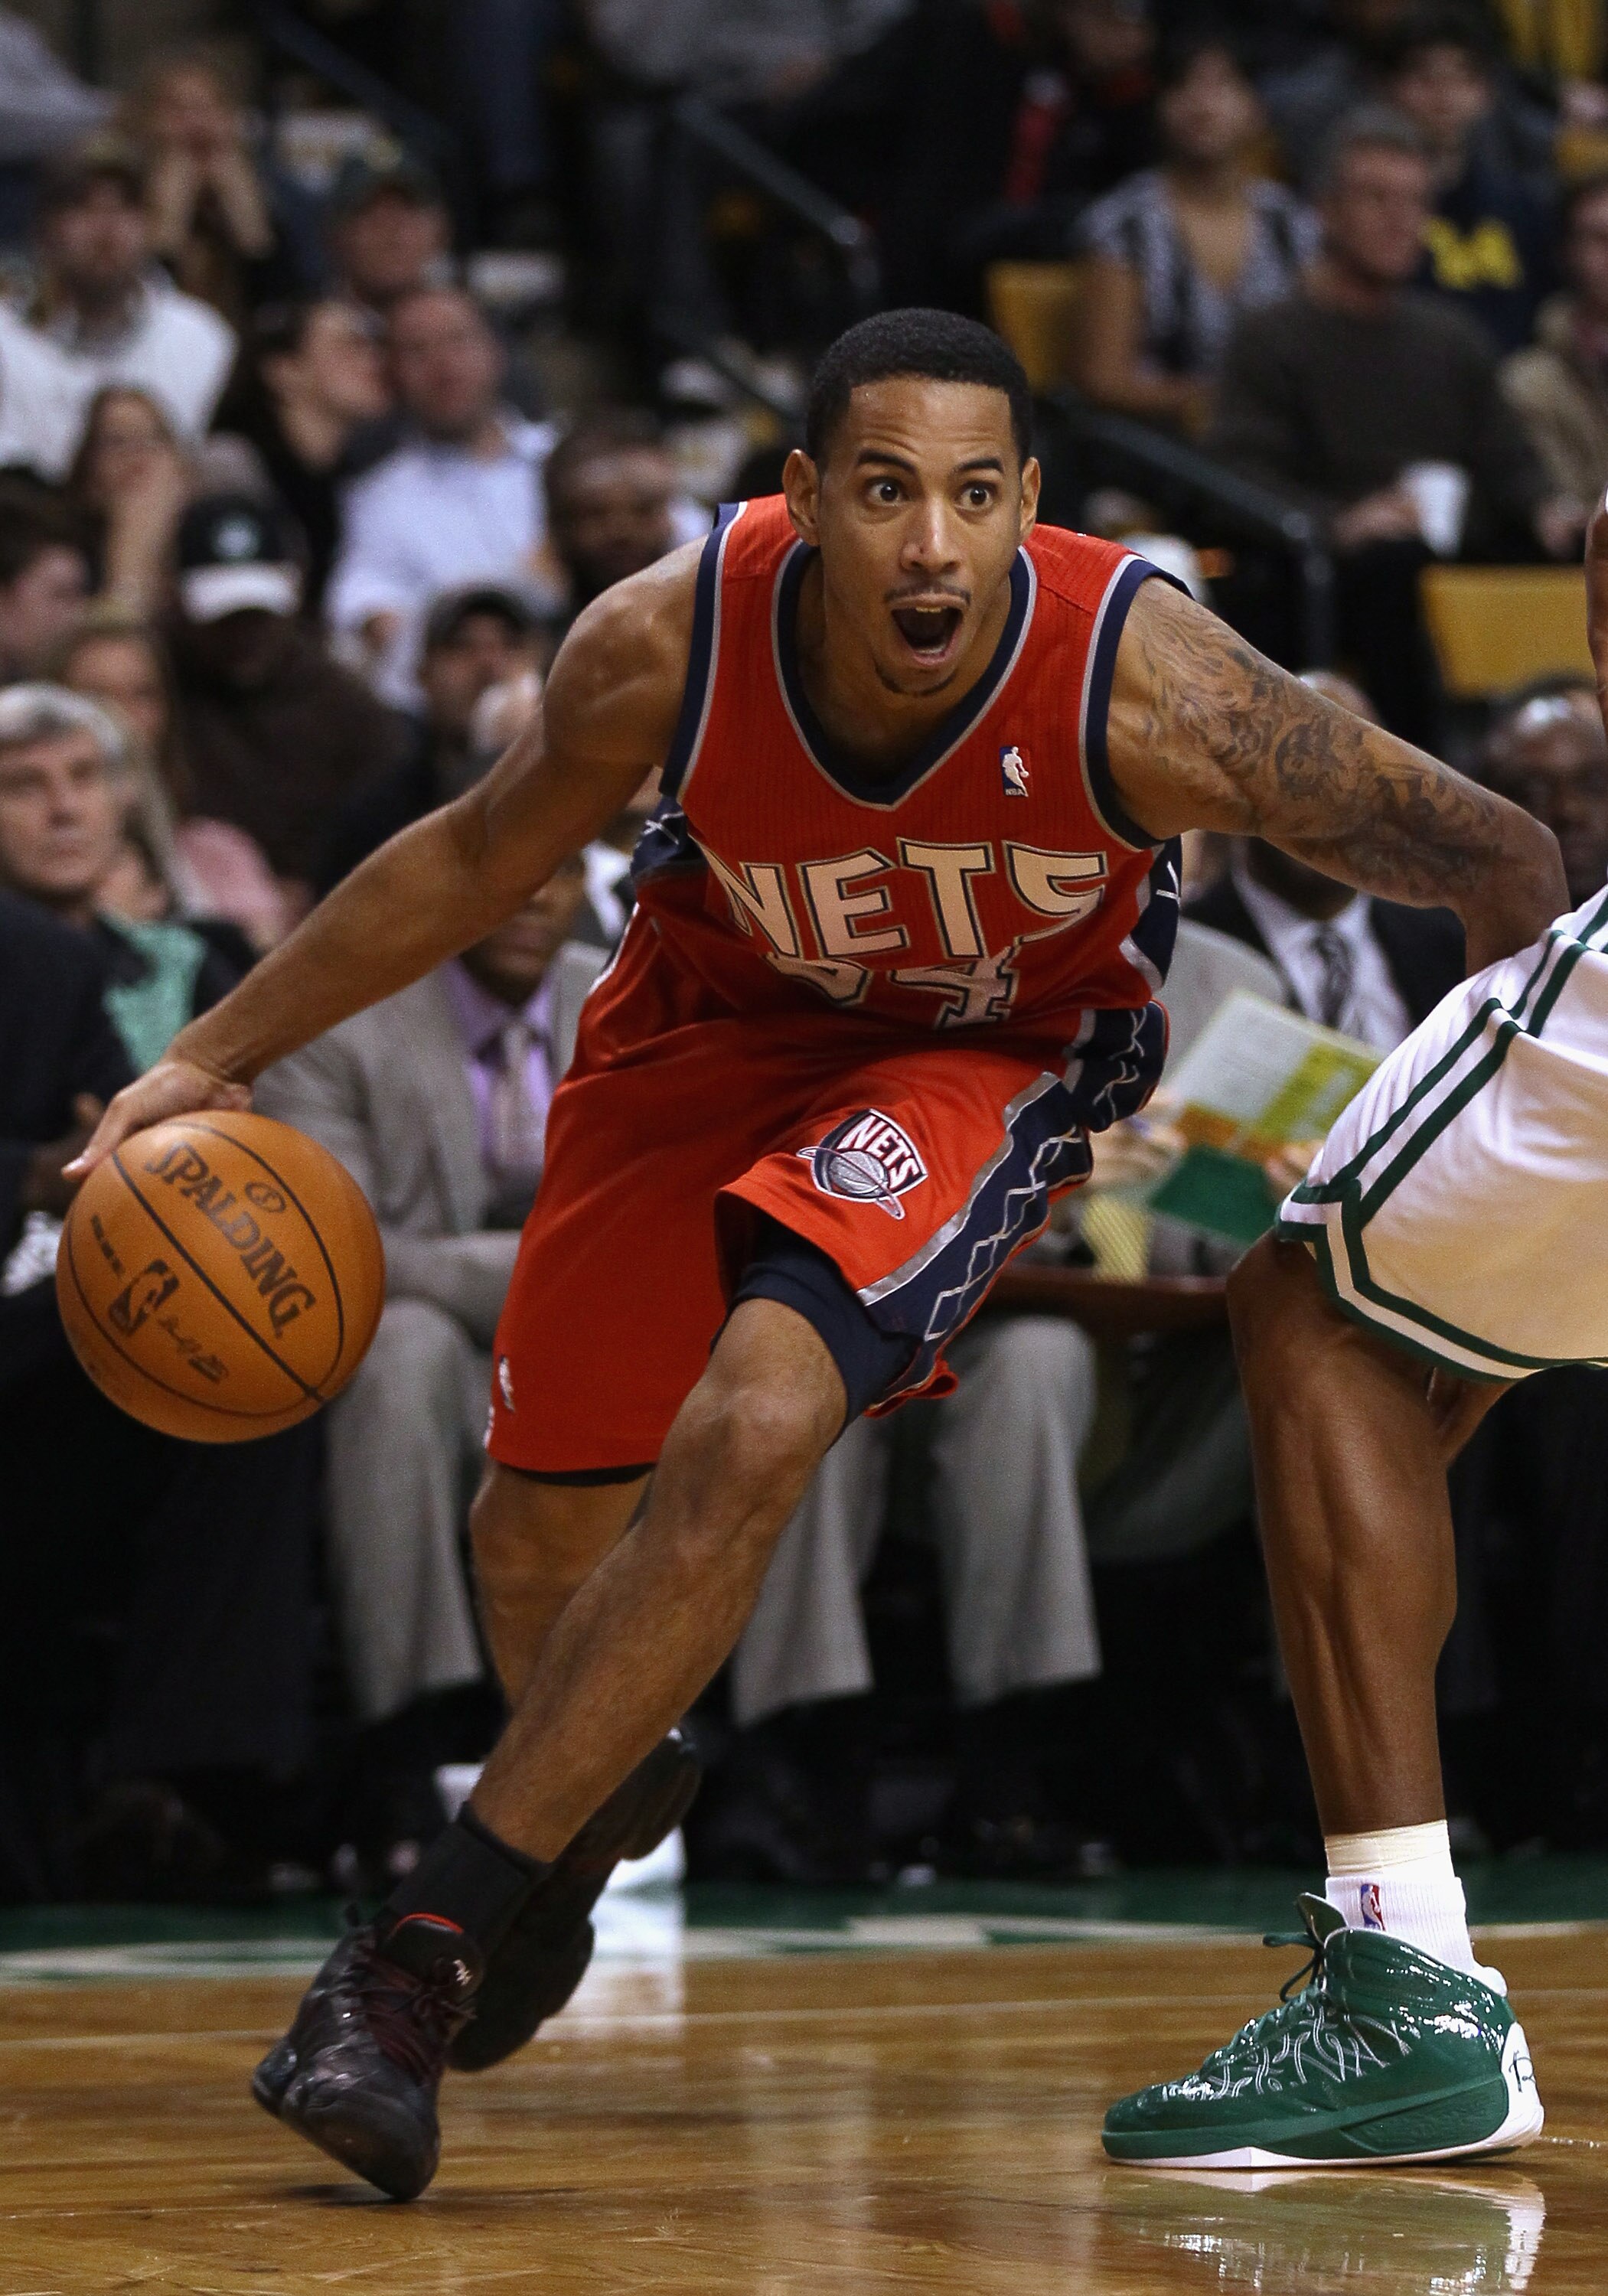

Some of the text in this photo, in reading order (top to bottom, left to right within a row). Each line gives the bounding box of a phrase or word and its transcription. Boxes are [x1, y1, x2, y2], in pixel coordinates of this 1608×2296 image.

[688, 835, 1107, 960] NETS
[837, 1114, 920, 1189] NETS
[144, 1140, 317, 1340] SPALDING
